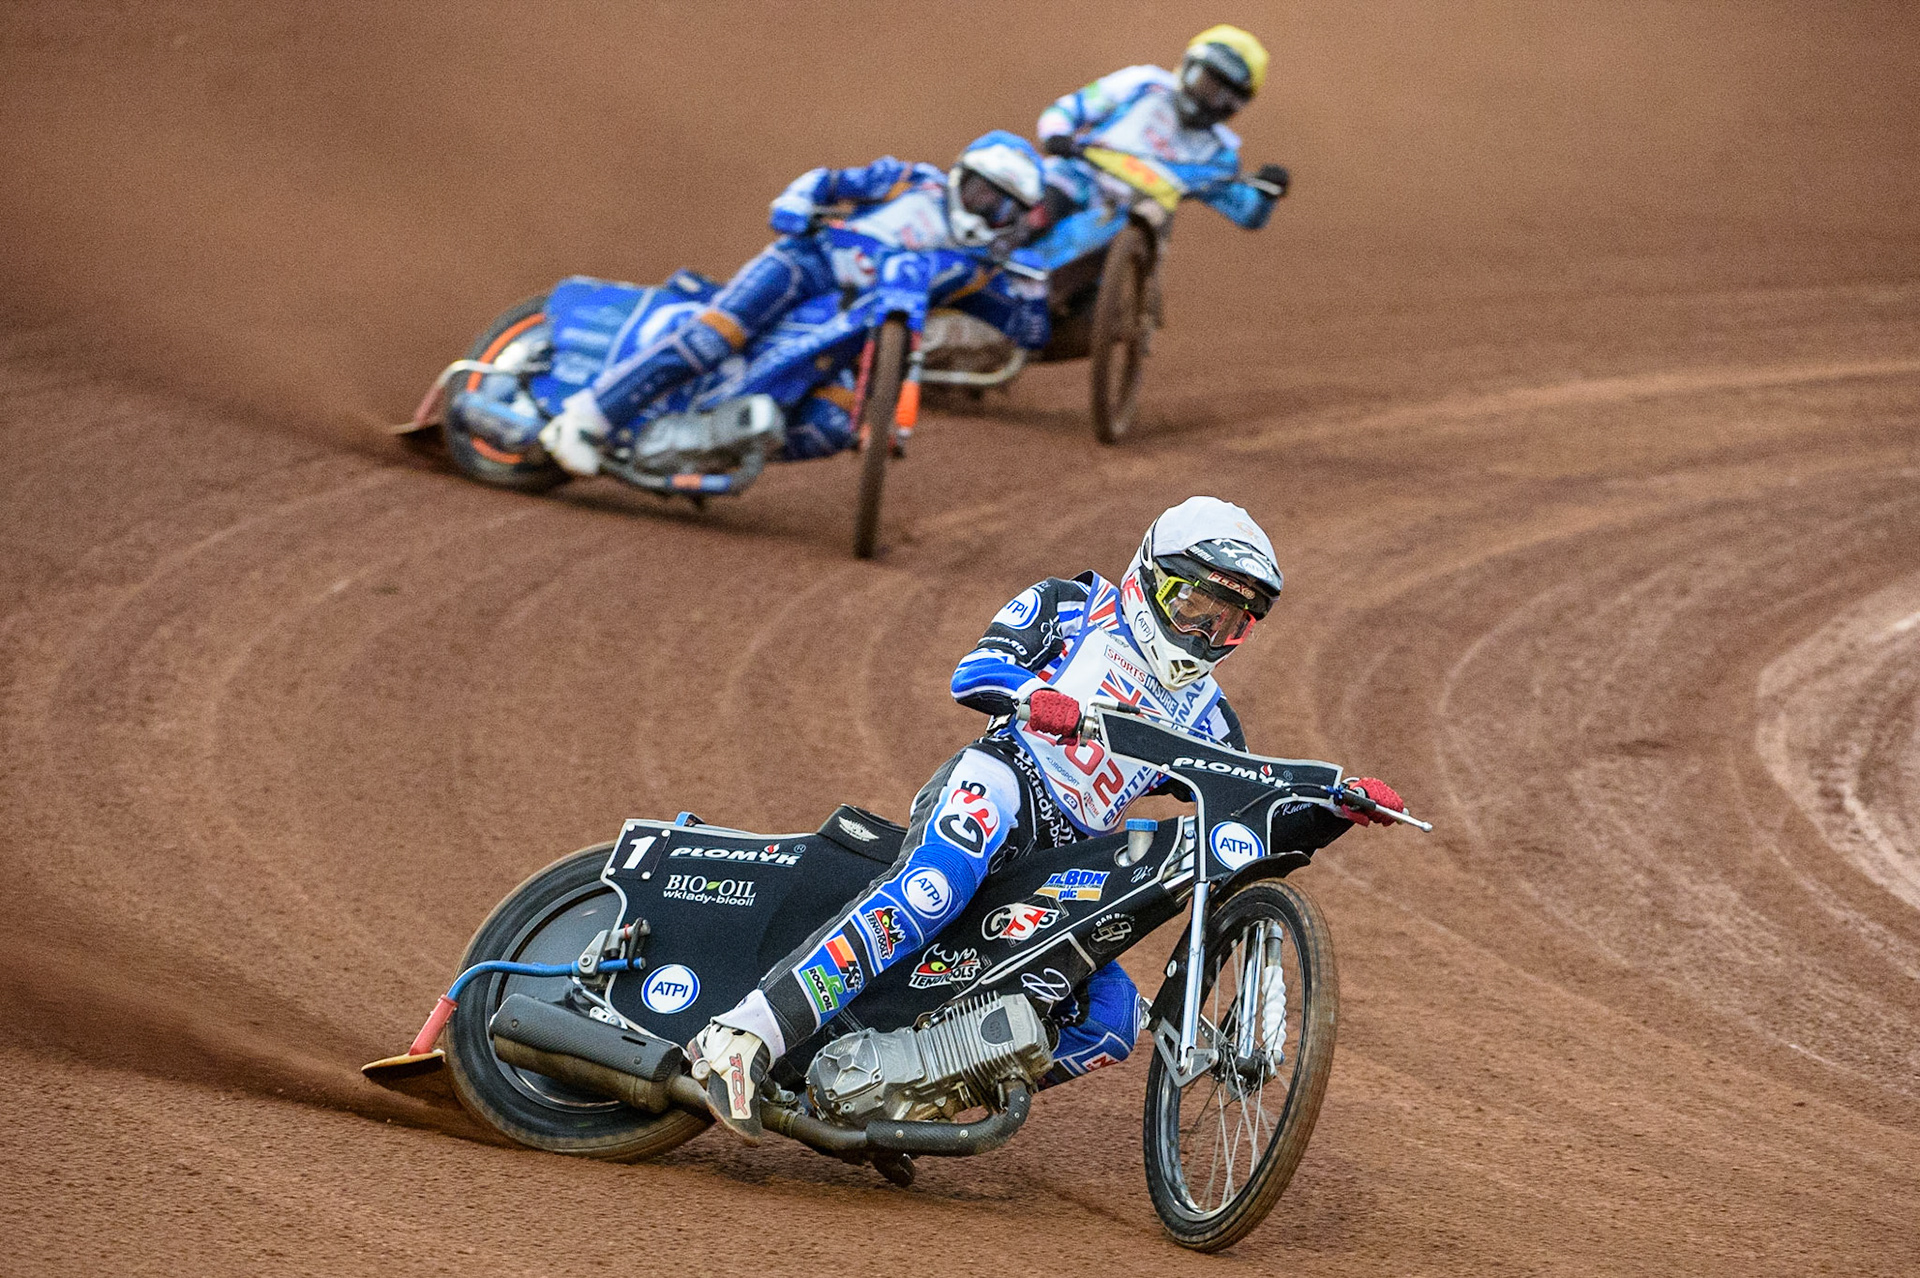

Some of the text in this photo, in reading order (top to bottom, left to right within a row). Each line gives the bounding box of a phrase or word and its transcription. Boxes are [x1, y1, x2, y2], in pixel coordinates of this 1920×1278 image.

[1138, 617, 1152, 638] ATPI
[1107, 648, 1179, 714] SPORTS INSURE
[622, 836, 657, 870] 1
[1219, 837, 1253, 857] ATPI
[915, 877, 943, 906] ATPI
[1058, 889, 1078, 900] plc
[1095, 914, 1113, 927] DAN
[652, 981, 689, 998] ATPI
[808, 968, 834, 1011] ROCK OIL
